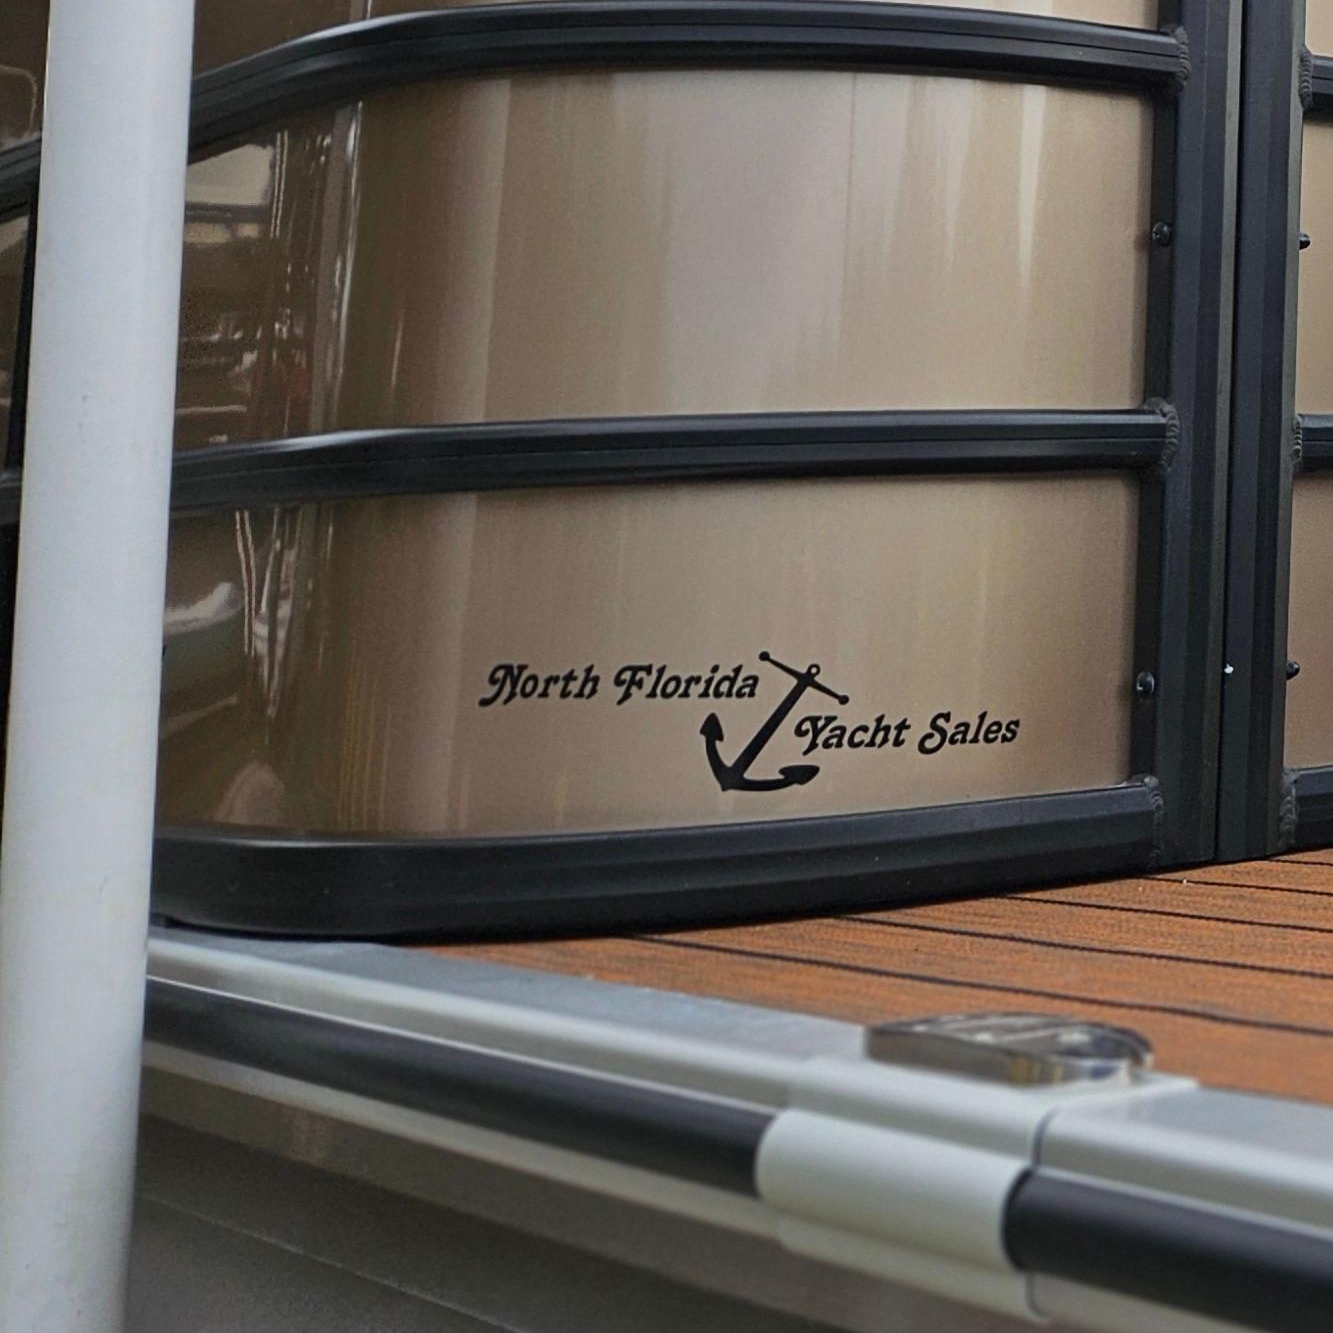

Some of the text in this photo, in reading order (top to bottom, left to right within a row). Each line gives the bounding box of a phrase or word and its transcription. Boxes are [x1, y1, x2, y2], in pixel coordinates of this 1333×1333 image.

[478, 663, 760, 707] North Florida
[793, 711, 1020, 756] Yacht Sales
